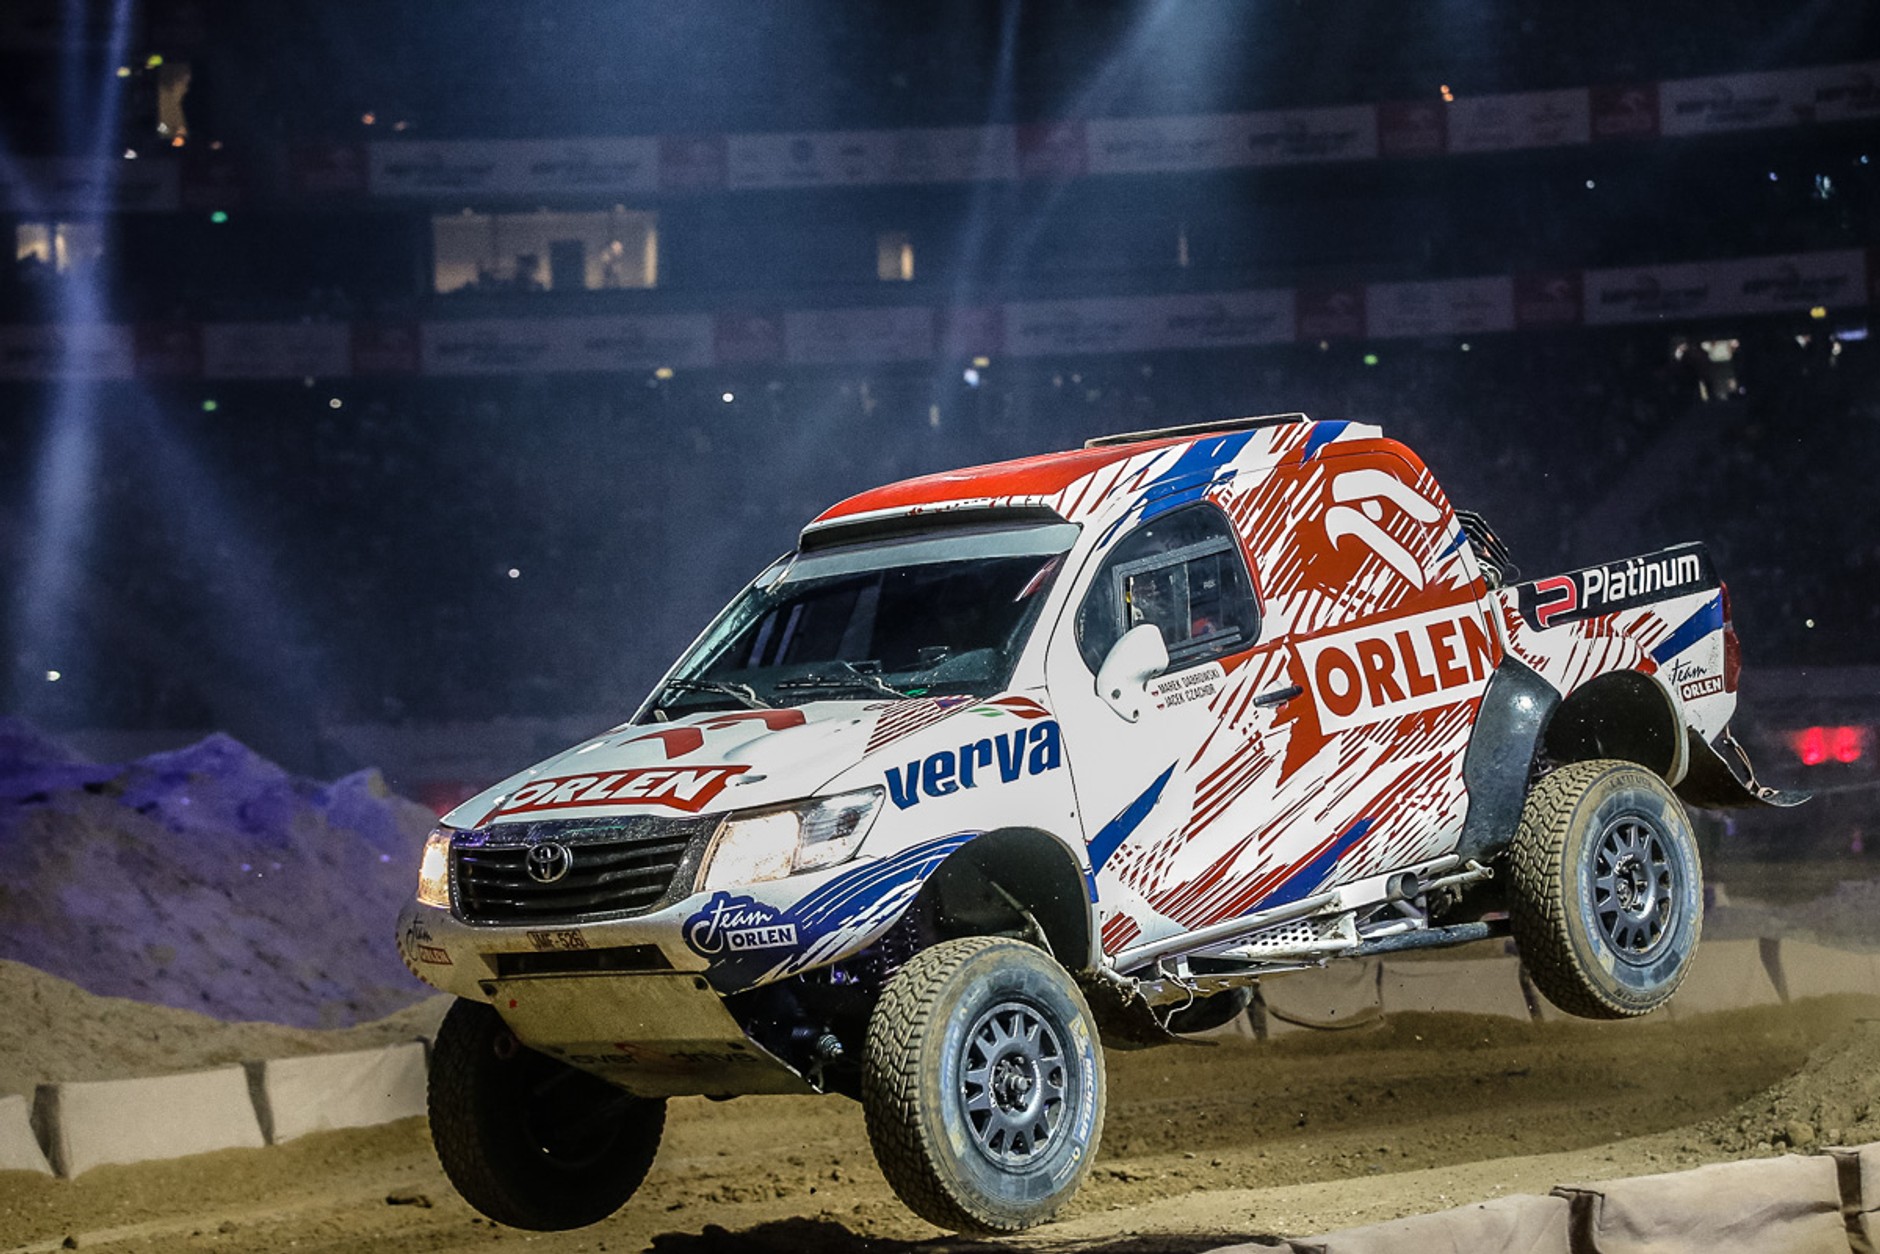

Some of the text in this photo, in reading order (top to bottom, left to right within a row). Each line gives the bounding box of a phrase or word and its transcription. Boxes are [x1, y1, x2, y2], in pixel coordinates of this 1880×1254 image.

[1582, 554, 1700, 609] Platinum
[1315, 609, 1503, 717] ORLEN
[1682, 677, 1722, 699] ORLEN
[502, 769, 727, 811] ORLEN
[884, 719, 1061, 811] verva
[698, 899, 773, 948] team
[731, 927, 793, 948] ORLEN
[1080, 1057, 1094, 1143] MICHELIN
